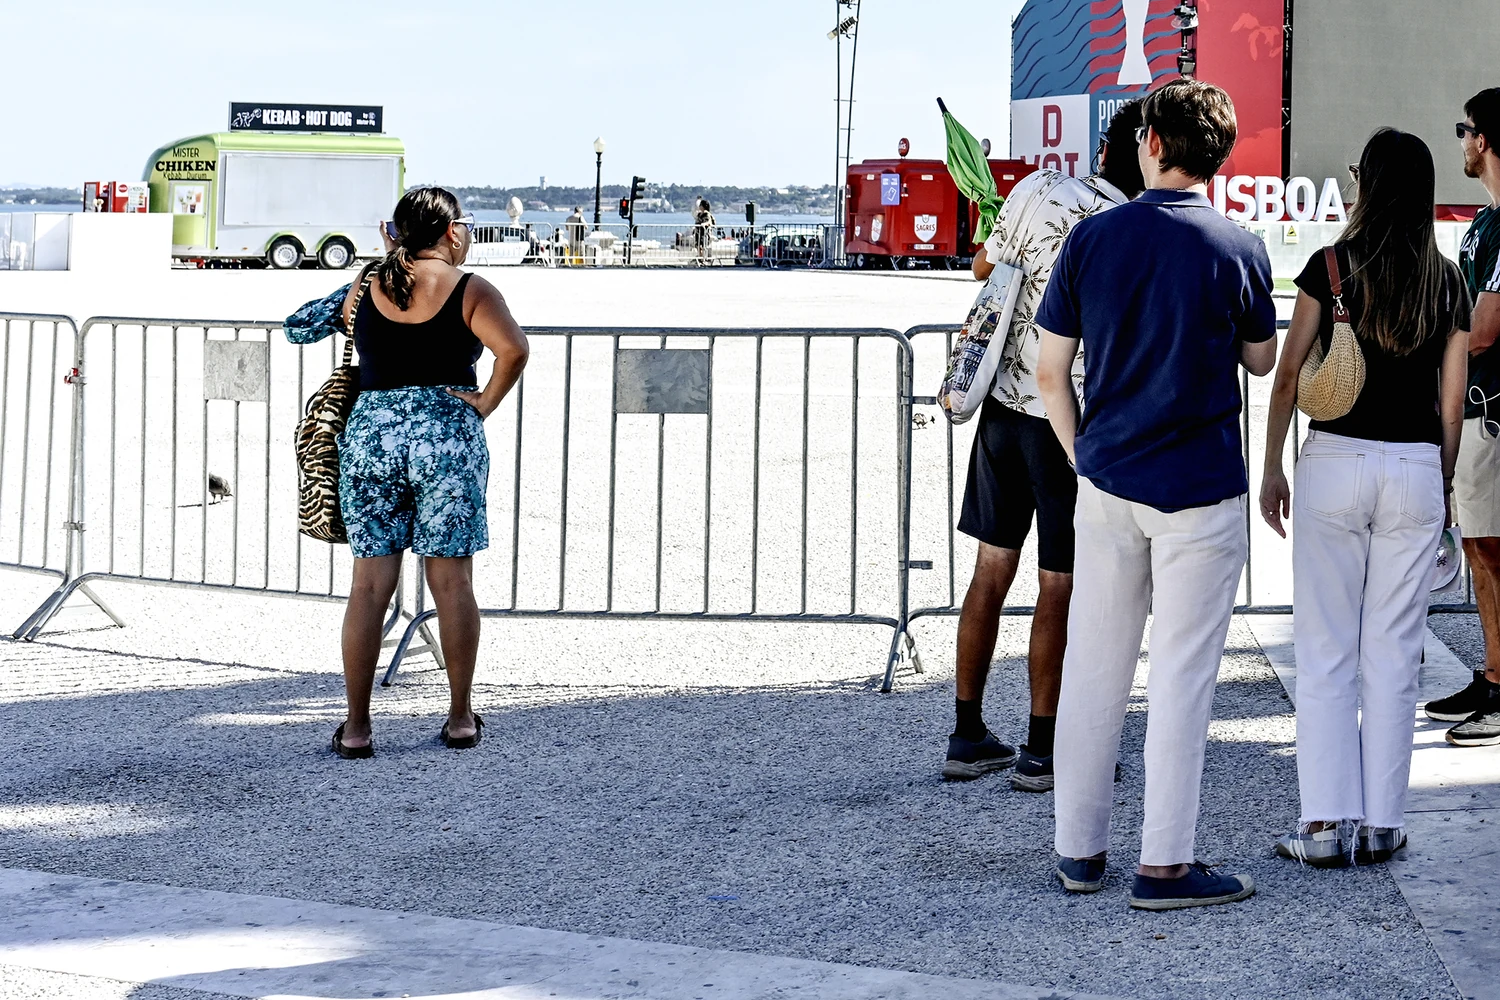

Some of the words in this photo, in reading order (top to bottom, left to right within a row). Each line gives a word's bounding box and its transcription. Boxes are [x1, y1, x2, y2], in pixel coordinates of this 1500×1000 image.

[262, 109, 300, 125] KEBAB
[305, 110, 328, 126] HOT
[329, 111, 352, 127] DOG
[172, 147, 200, 158] MISTER
[155, 160, 217, 172] CHIKEN
[1214, 175, 1348, 222] ISBOA
